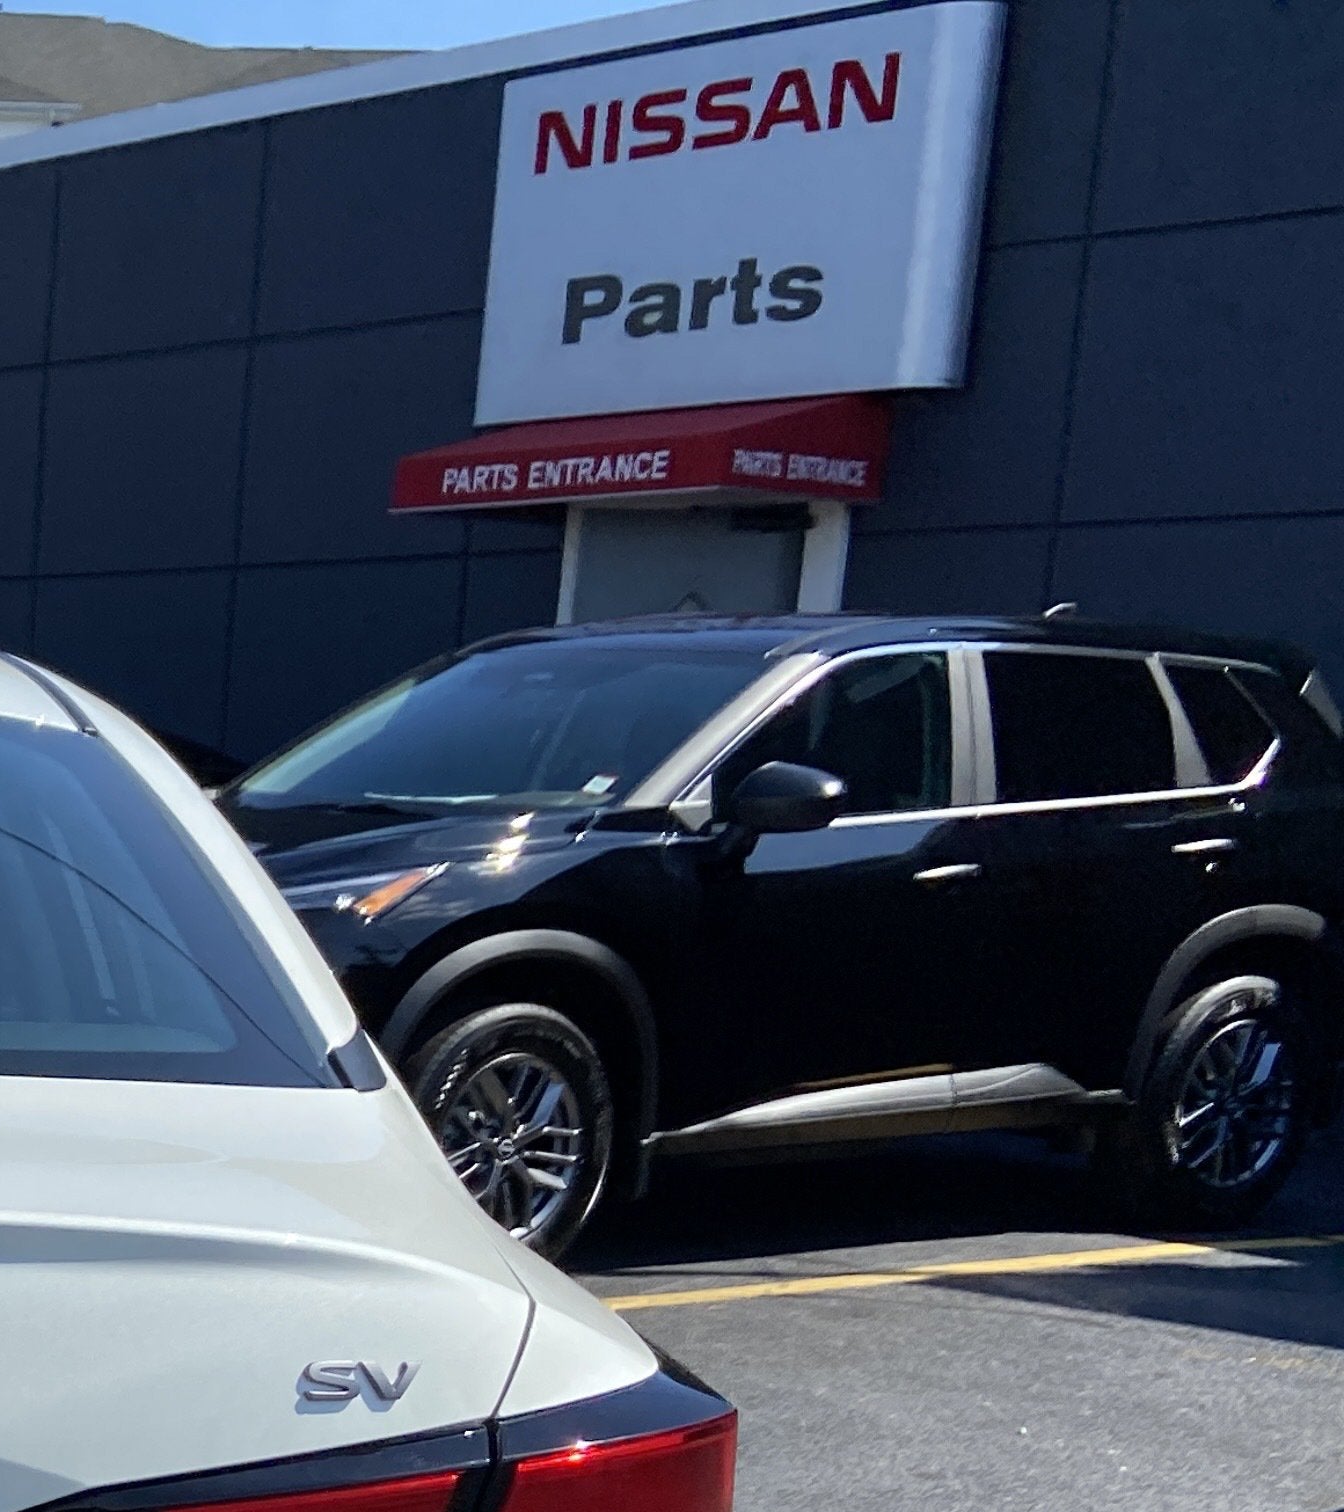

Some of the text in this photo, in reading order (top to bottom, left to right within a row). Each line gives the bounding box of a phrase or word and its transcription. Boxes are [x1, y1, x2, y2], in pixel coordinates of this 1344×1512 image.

[534, 52, 900, 175] NISSAN
[561, 257, 824, 345] Parts
[442, 450, 670, 494] PARTS ENTRANCE
[732, 449, 869, 487] PARTS ENTRANCE
[302, 1360, 423, 1401] SV
